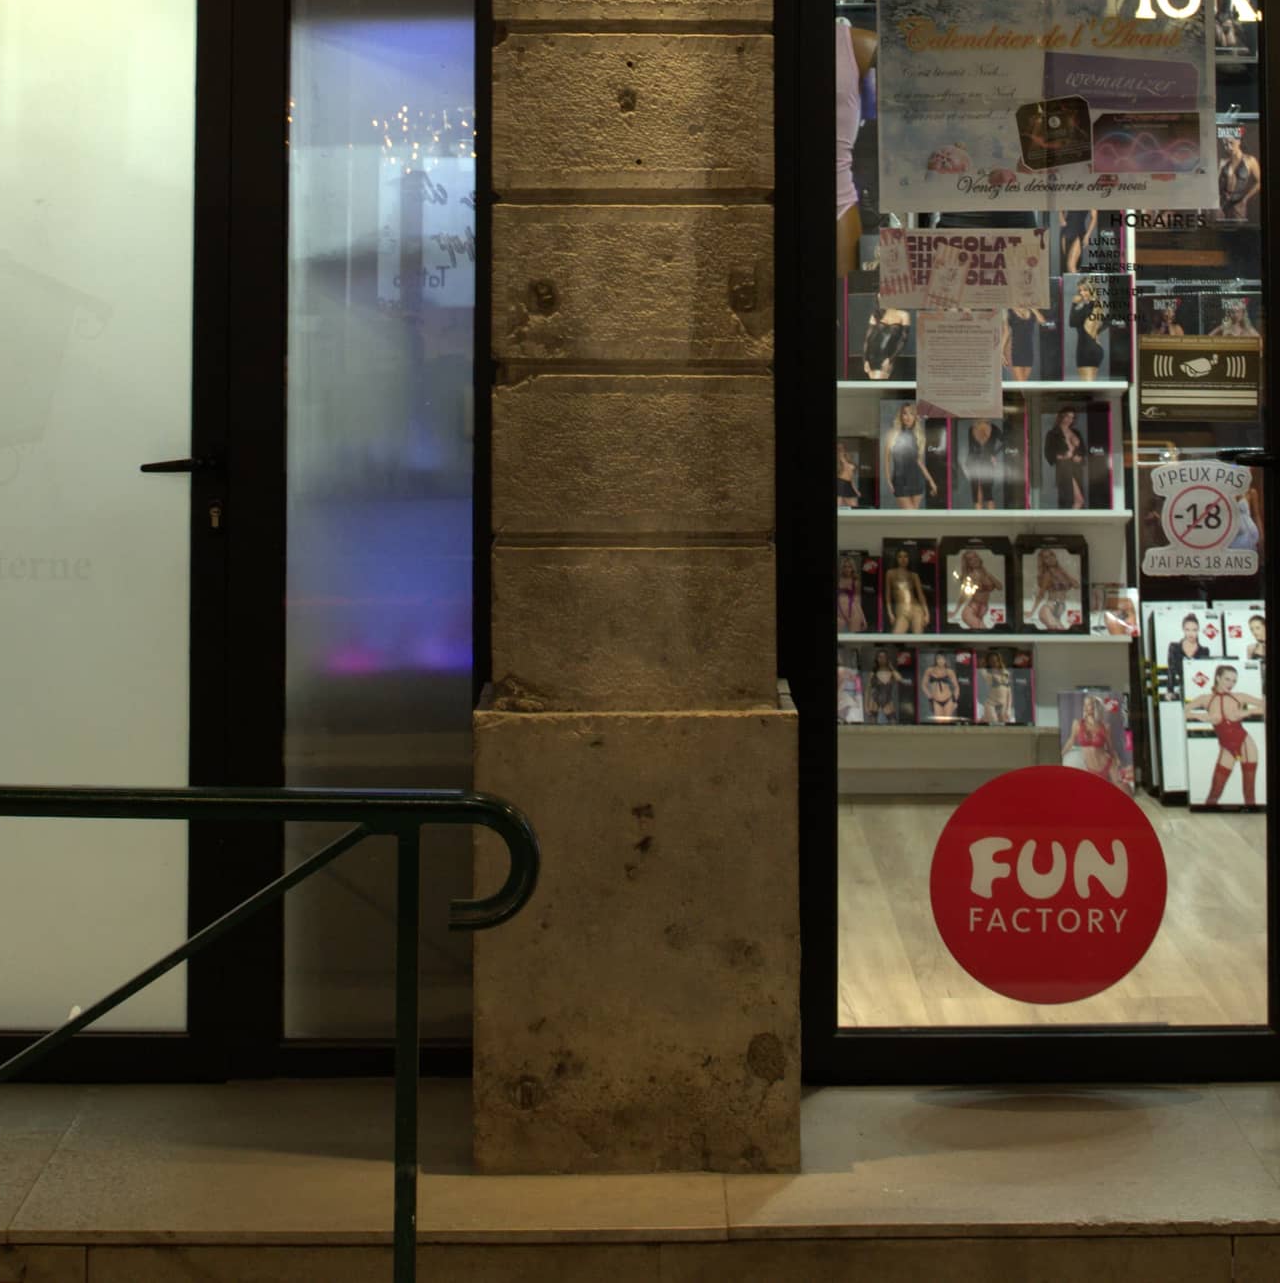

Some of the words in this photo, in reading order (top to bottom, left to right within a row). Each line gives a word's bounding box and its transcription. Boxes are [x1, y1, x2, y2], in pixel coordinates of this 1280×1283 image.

[955, 175, 1001, 200] Venez
[1004, 180, 1021, 193] les
[1023, 179, 1085, 194] découvrir
[1086, 178, 1115, 199] chez
[1117, 180, 1148, 192] nous
[1109, 213, 1207, 229] HORAIRES
[1157, 467, 1211, 488] J'PEUX
[1215, 467, 1246, 489] PAS
[1174, 503, 1222, 530] -18
[1150, 555, 1170, 569] J'AI
[1176, 555, 1201, 569] PAS
[1206, 555, 1221, 569] 18
[1225, 555, 1253, 570] ANS
[967, 836, 1130, 900] FUN
[968, 907, 1129, 935] FACTORY
